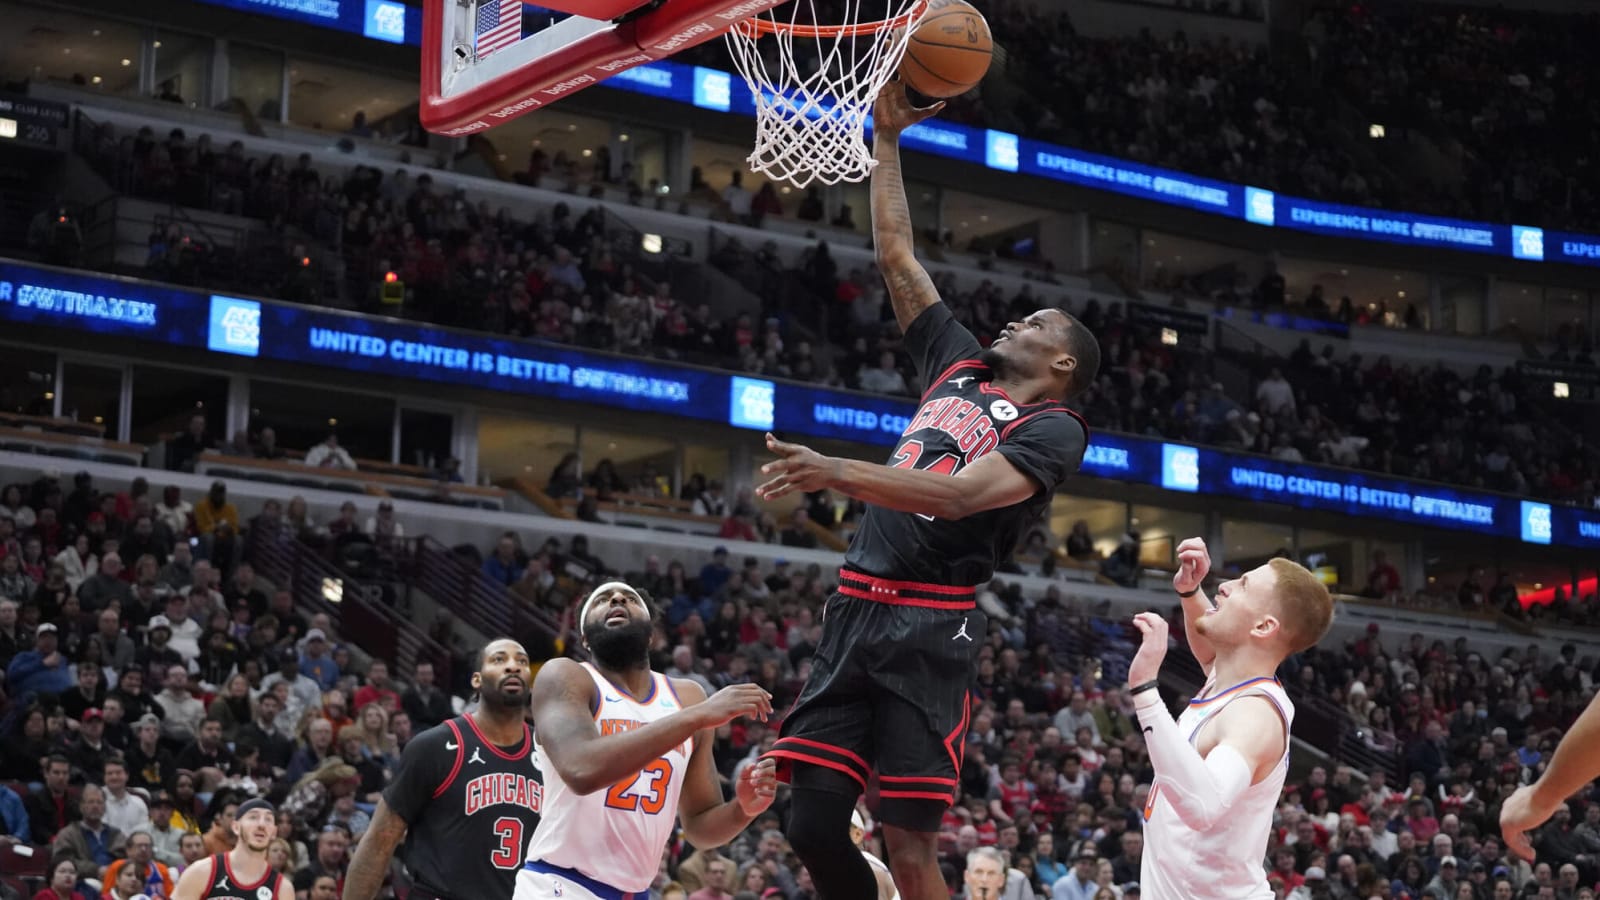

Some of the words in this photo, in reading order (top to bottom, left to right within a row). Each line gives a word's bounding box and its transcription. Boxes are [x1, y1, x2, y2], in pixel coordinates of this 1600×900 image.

[655, 22, 714, 51] betway
[598, 53, 653, 72] betway
[541, 73, 596, 95] betway
[490, 97, 542, 118] betway
[1037, 152, 1115, 182] EXPERIENCE
[1291, 207, 1369, 232] EXPERIENCE
[1371, 218, 1410, 236] MORE
[17, 284, 156, 325] #WITHAMEX
[310, 327, 386, 357] UNITED
[390, 339, 469, 369] CENTER
[473, 351, 494, 373] IS
[496, 355, 570, 383] BETTER
[815, 403, 877, 430] UNITED
[903, 396, 999, 466] CHICAGO
[1232, 467, 1285, 491] UNITED
[1287, 476, 1341, 499] CENTER
[1344, 485, 1358, 502] IS
[1360, 487, 1411, 510] BETTER
[465, 773, 544, 816] CHICAG
[604, 757, 673, 815] 23
[491, 817, 524, 870] 3
